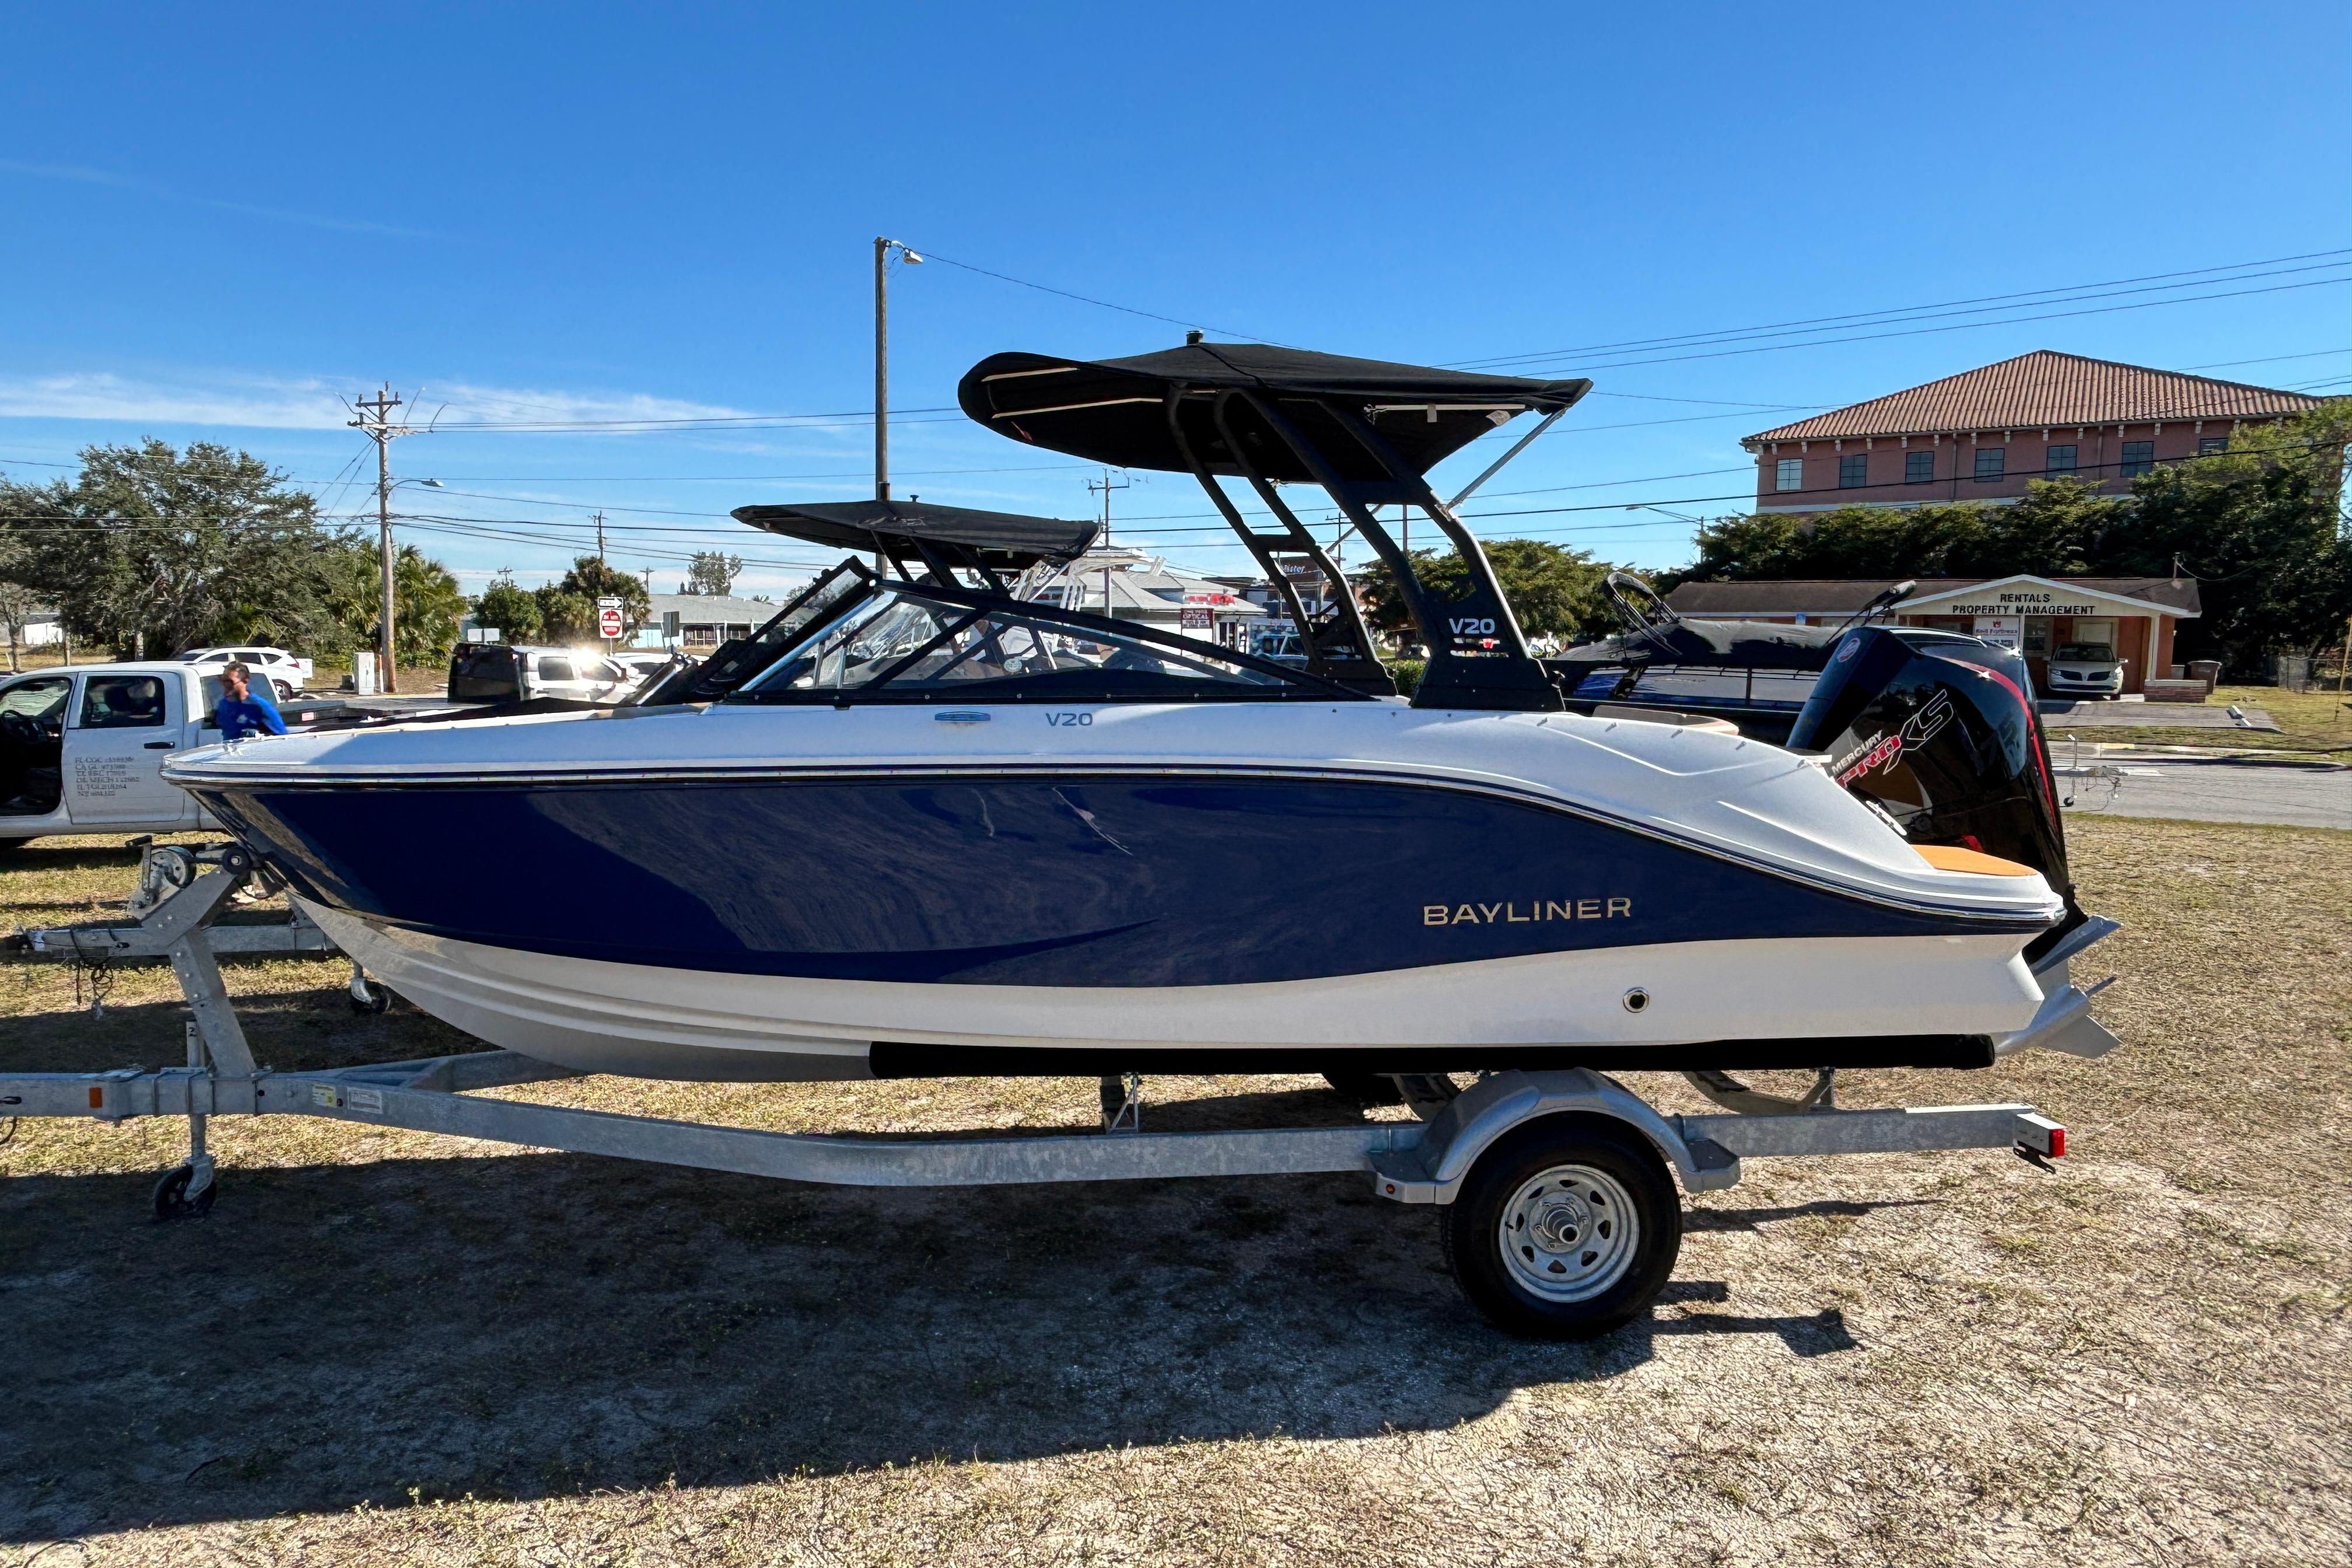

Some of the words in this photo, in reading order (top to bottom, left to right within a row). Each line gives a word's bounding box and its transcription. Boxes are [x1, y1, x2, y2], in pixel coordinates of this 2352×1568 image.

[2000, 594, 2050, 603] RENTALS
[1952, 605, 2010, 614] PROPERTY
[2015, 606, 2095, 615] MANAGEMENT
[1448, 618, 1495, 634] V20
[1045, 713, 1093, 726] V20
[1831, 729, 1883, 775] MERCURY
[1423, 897, 1632, 926] BAYLINER
